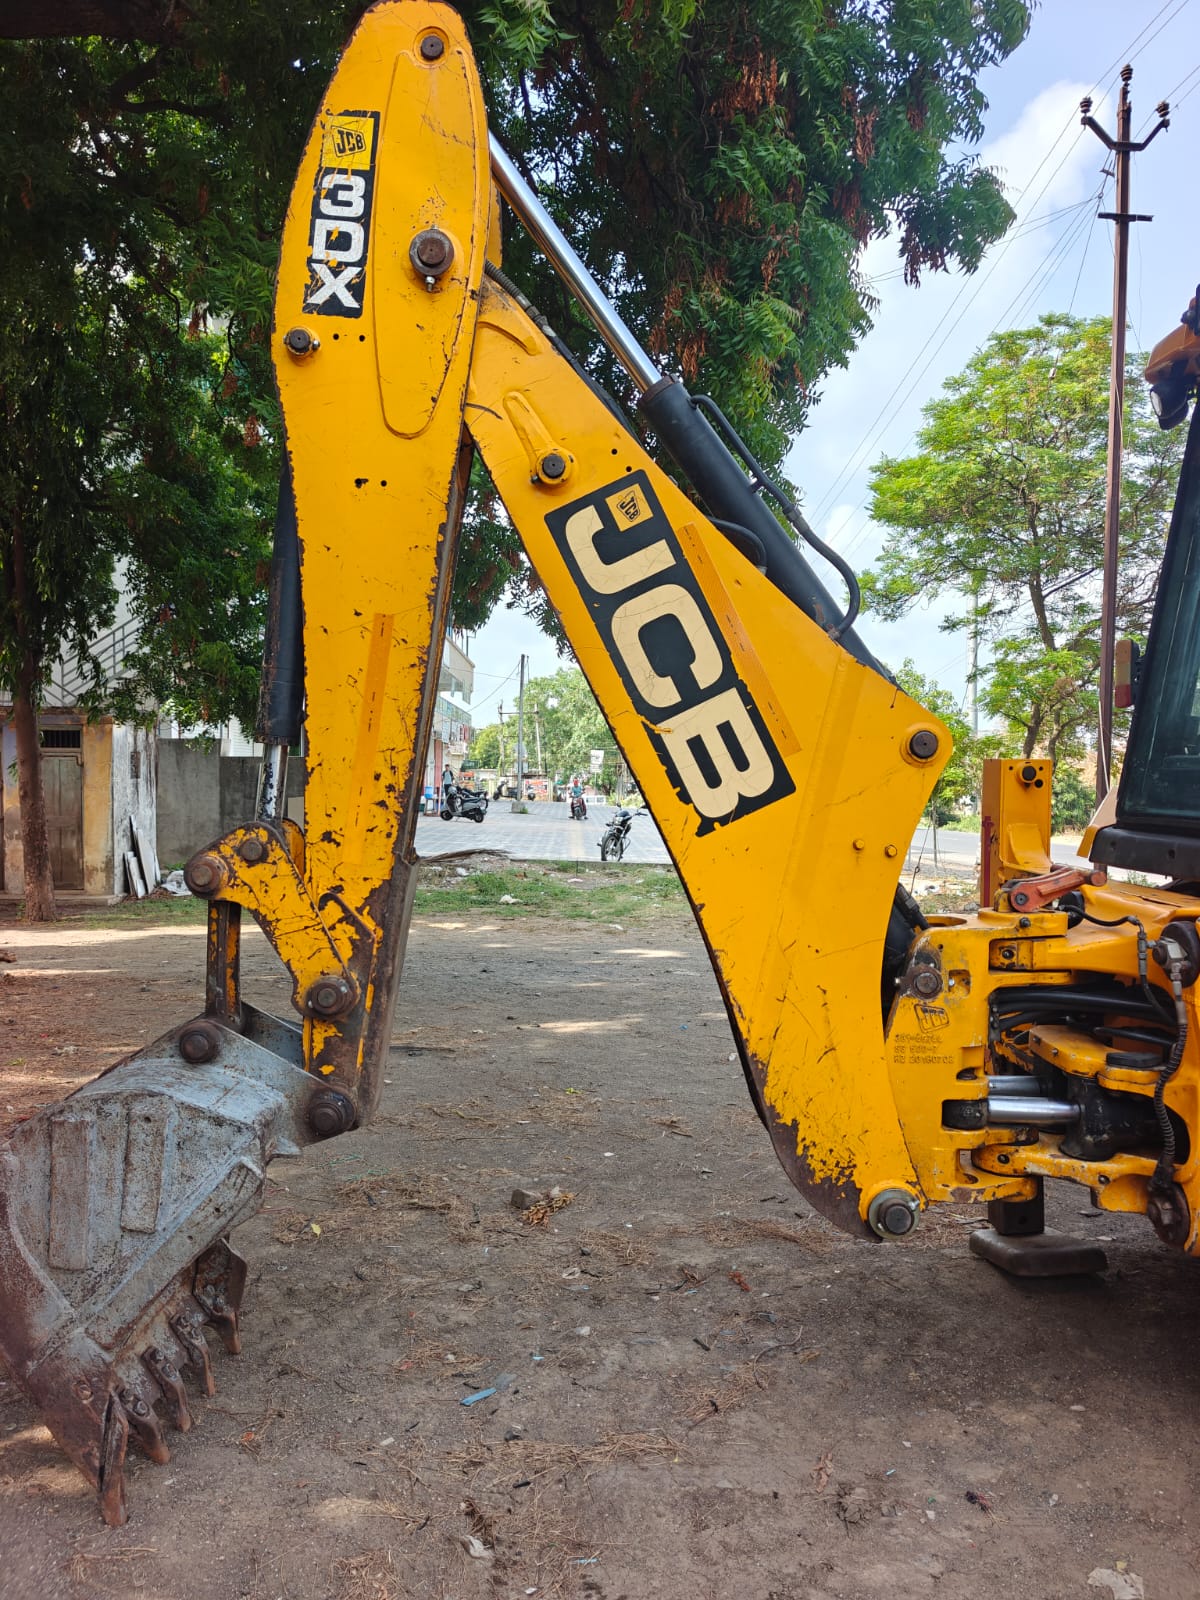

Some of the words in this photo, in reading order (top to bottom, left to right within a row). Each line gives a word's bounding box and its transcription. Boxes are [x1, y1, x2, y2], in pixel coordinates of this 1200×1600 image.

[335, 128, 365, 154] JCB
[306, 173, 366, 309] 3DX
[619, 496, 639, 520] JCB
[565, 504, 775, 819] JCB
